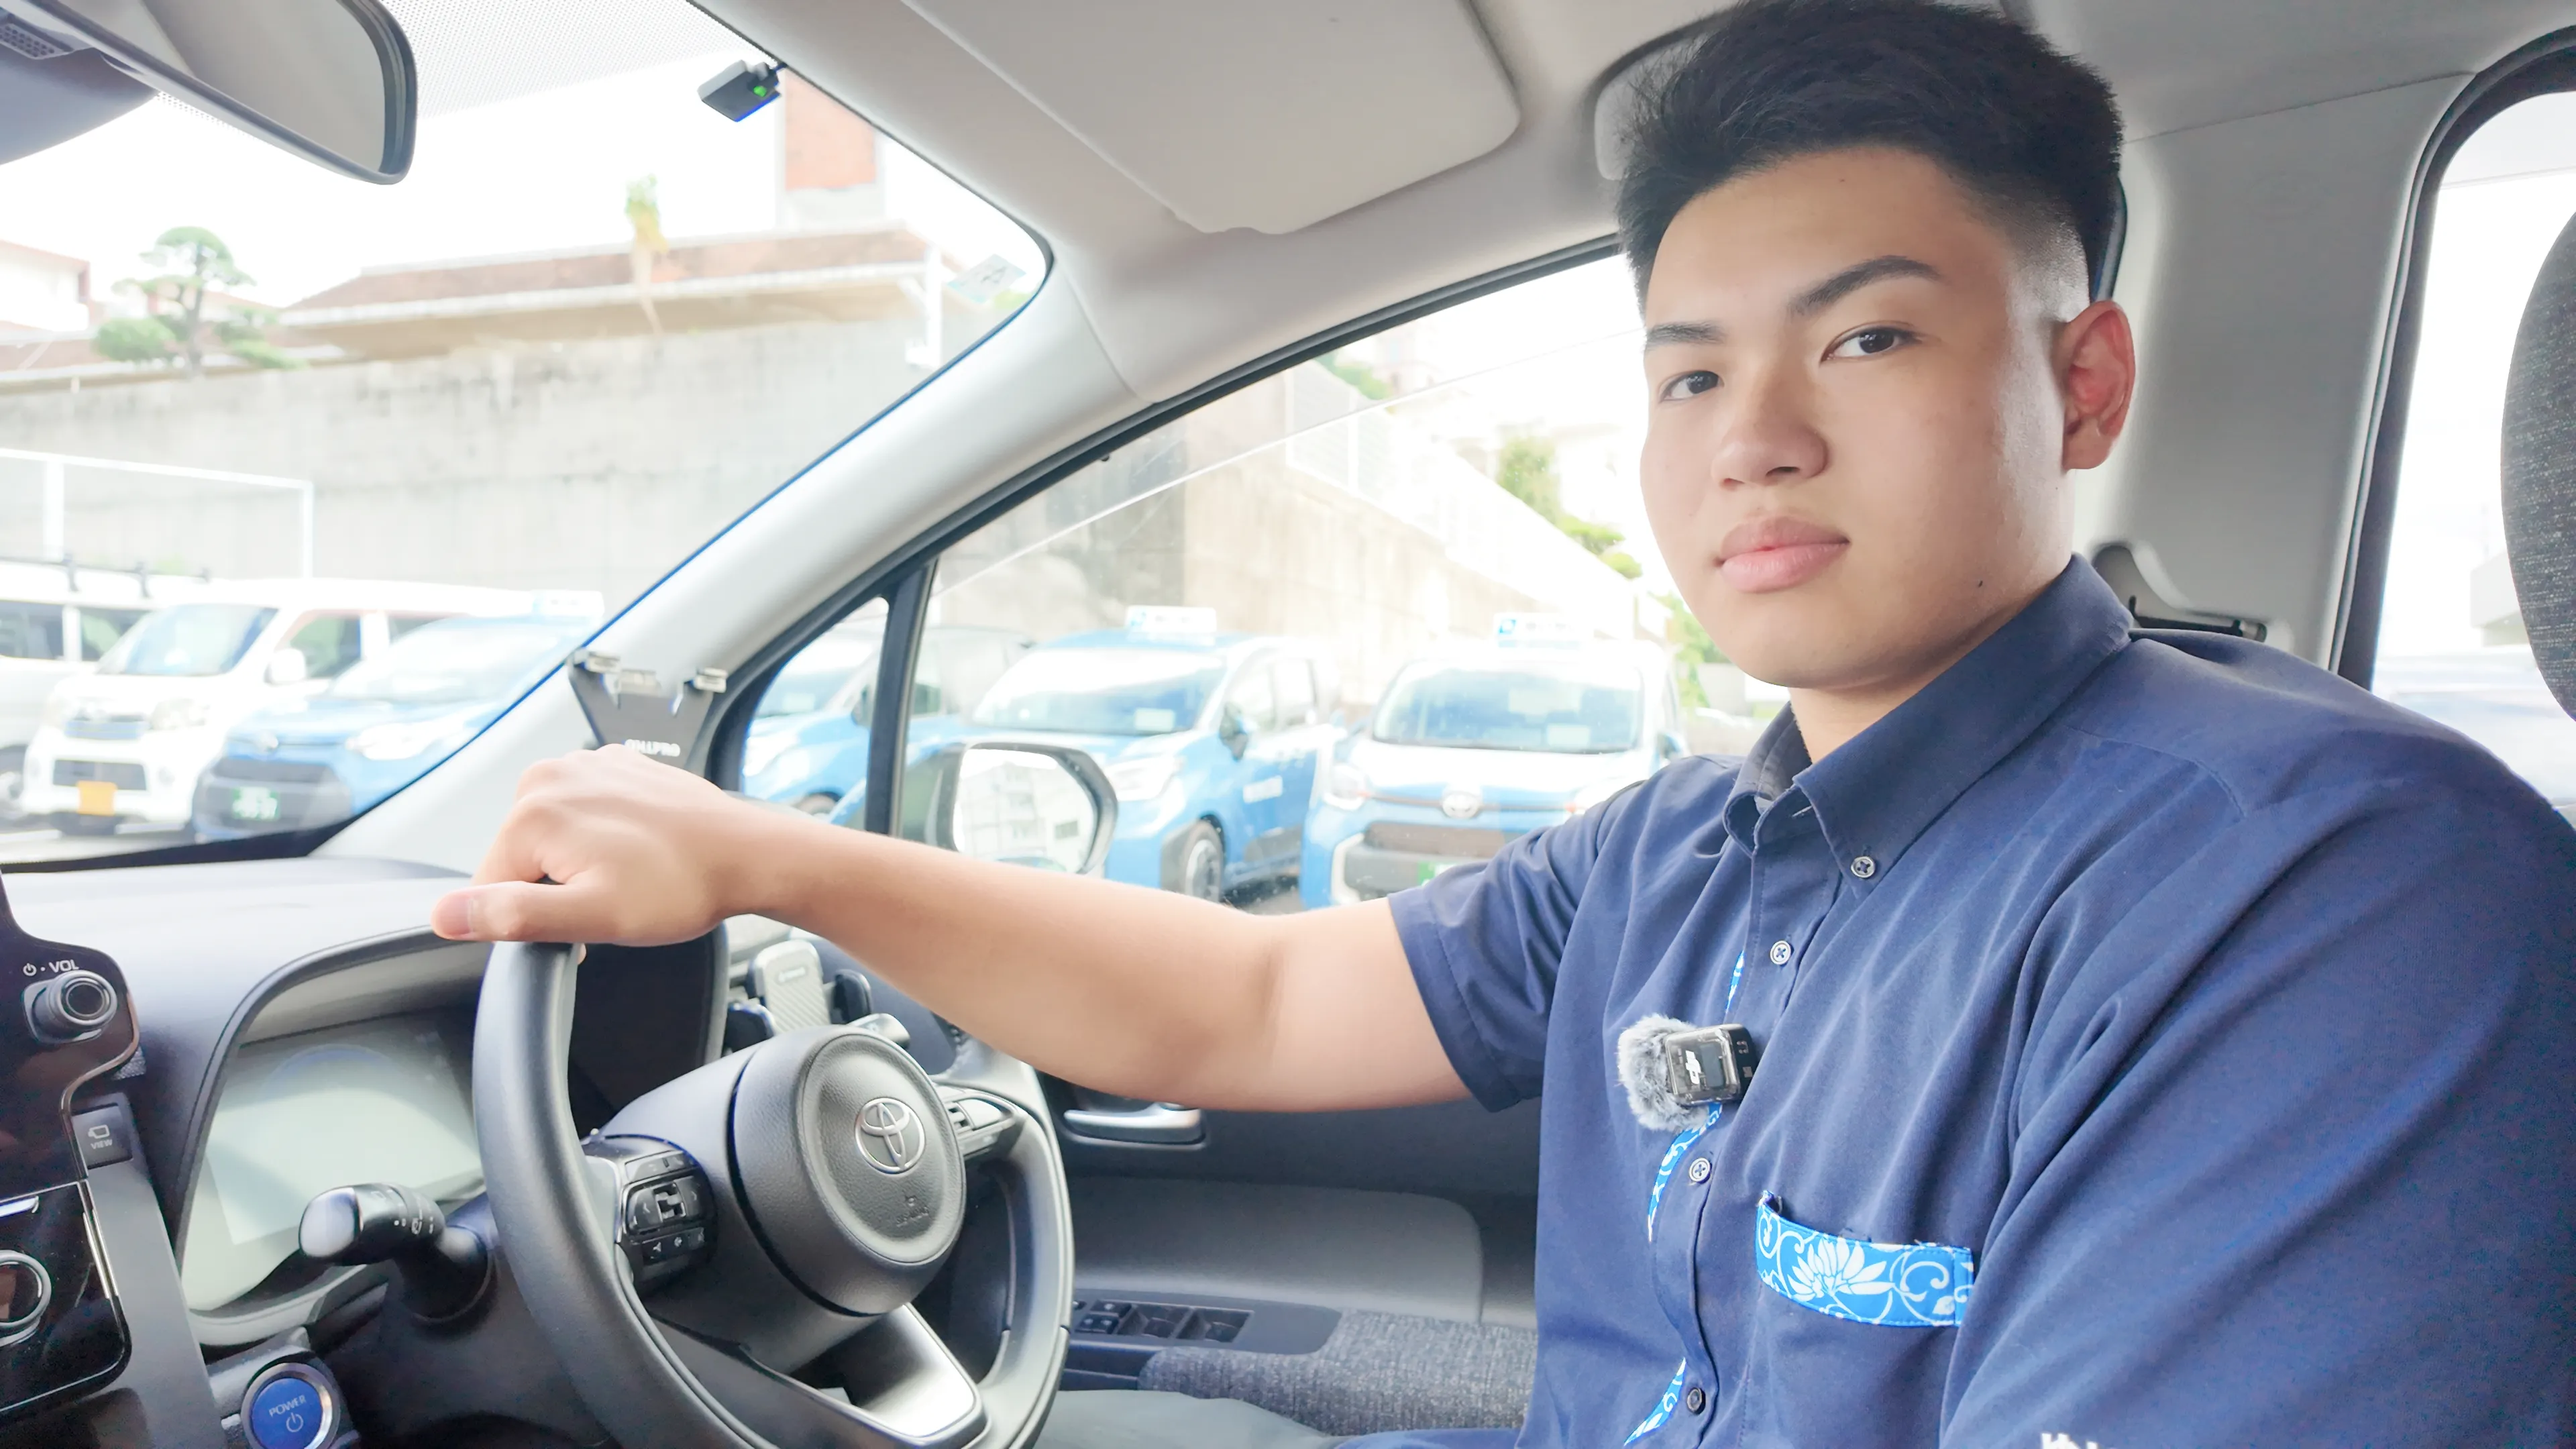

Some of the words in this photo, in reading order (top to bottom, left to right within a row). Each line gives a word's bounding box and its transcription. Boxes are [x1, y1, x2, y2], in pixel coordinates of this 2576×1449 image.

[48, 959, 79, 973] VOL
[90, 1139, 113, 1150] VIEW
[268, 1395, 307, 1418] POWER
